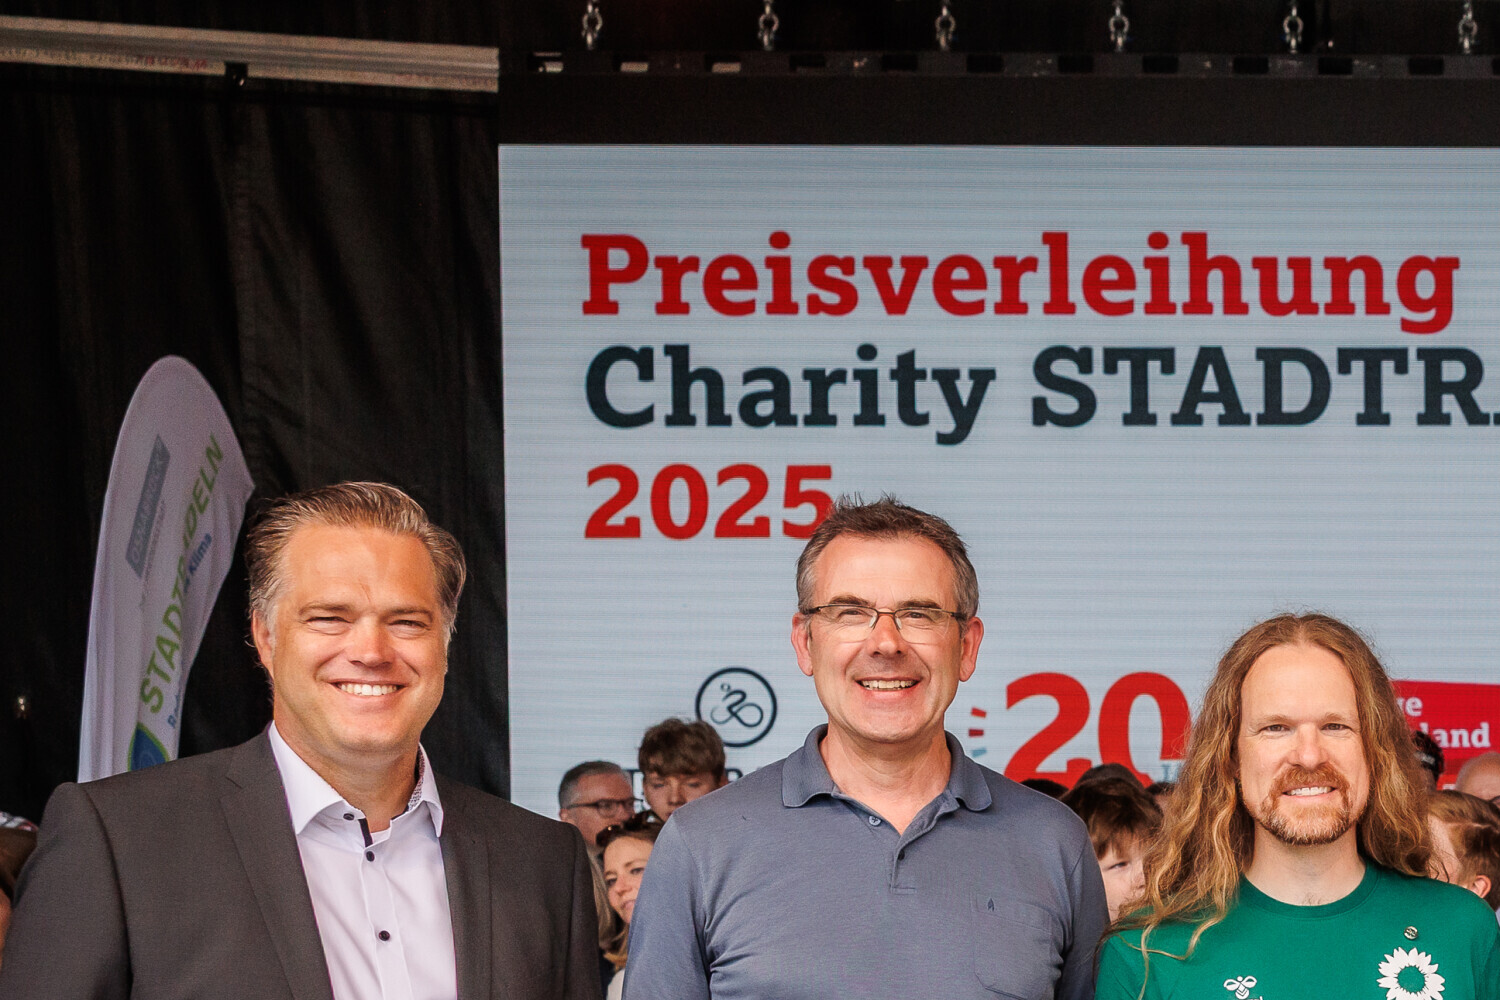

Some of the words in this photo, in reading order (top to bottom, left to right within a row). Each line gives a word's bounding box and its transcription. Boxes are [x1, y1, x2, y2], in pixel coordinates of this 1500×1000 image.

[580, 231, 1460, 334] Preisverleihung
[584, 344, 997, 445] Charity
[583, 464, 834, 540] 2025
